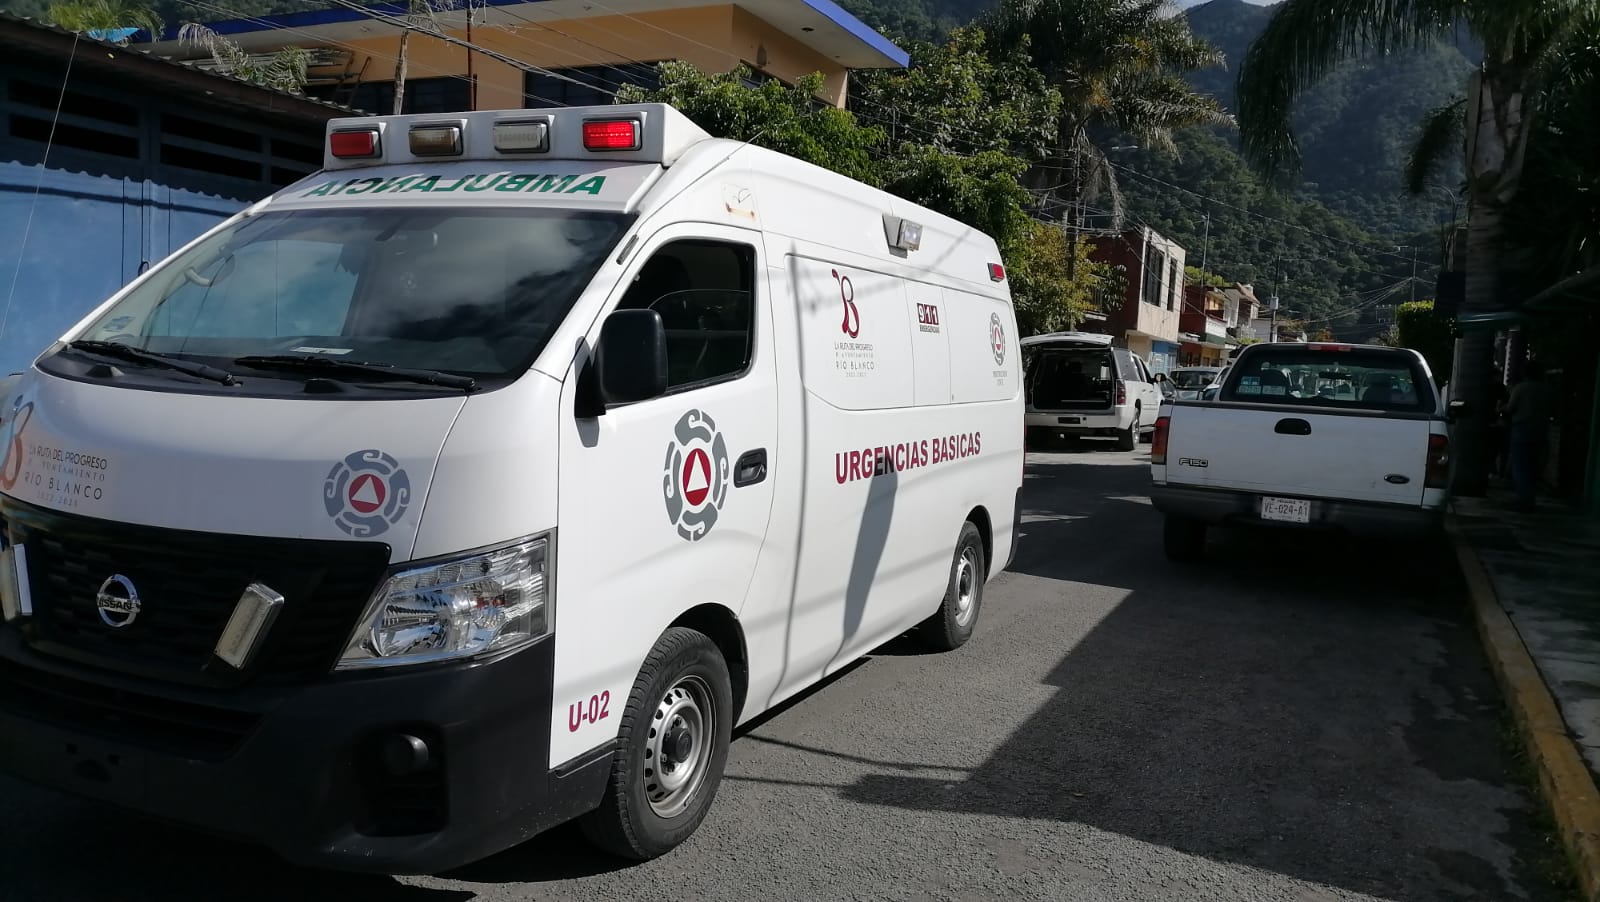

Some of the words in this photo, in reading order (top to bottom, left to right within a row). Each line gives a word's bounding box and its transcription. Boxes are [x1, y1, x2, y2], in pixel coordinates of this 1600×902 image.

[917, 303, 939, 325] 911
[52, 448, 64, 462] DEL
[65, 451, 108, 470] PROGRESO
[835, 439, 928, 484] URGENCIAS
[932, 431, 981, 464] BASICAS
[48, 477, 103, 500] BLANCO
[569, 690, 610, 732] U-02
